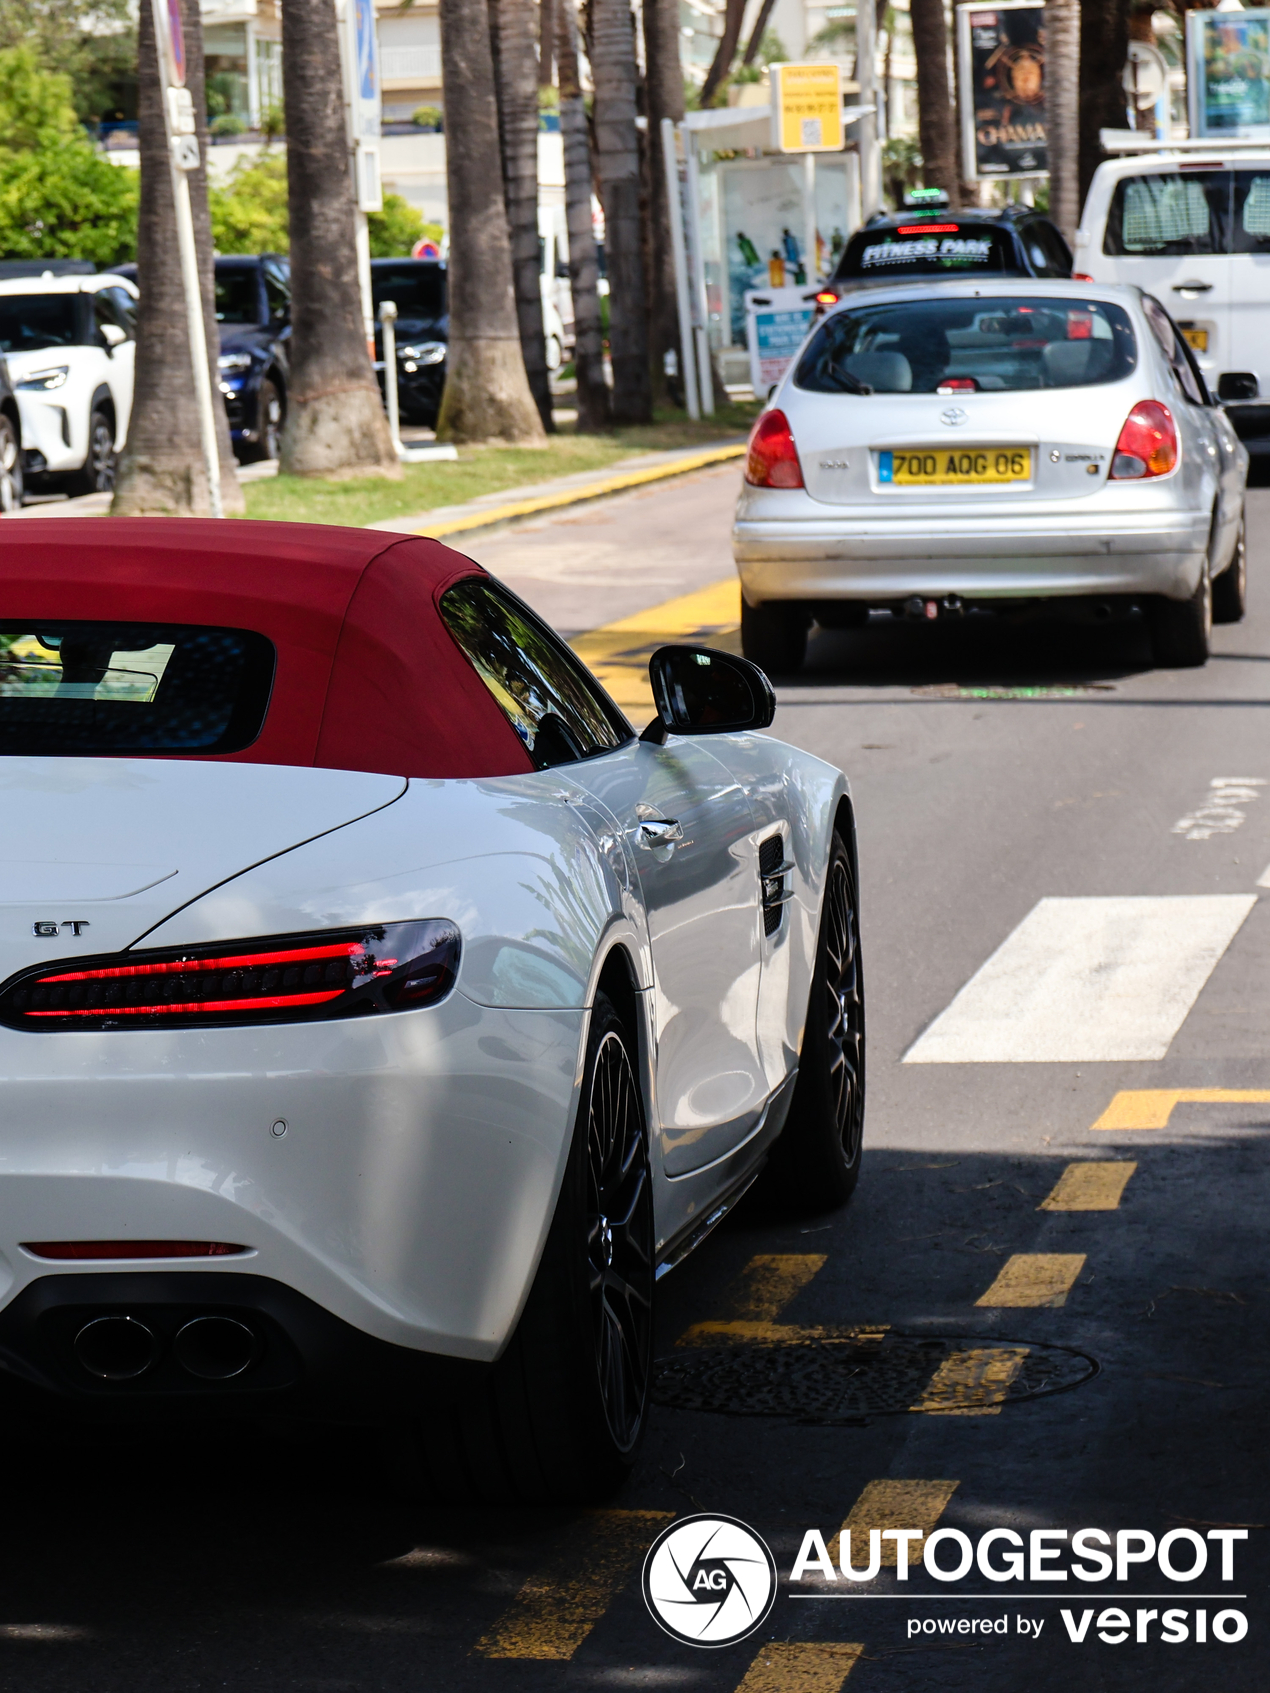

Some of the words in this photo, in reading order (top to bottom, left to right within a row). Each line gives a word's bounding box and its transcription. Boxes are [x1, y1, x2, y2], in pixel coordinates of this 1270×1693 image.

[862, 240, 938, 262] FITNESS
[940, 239, 992, 255] PARK
[894, 454, 936, 476] 700
[995, 453, 1025, 475] 06
[32, 920, 91, 937] GT
